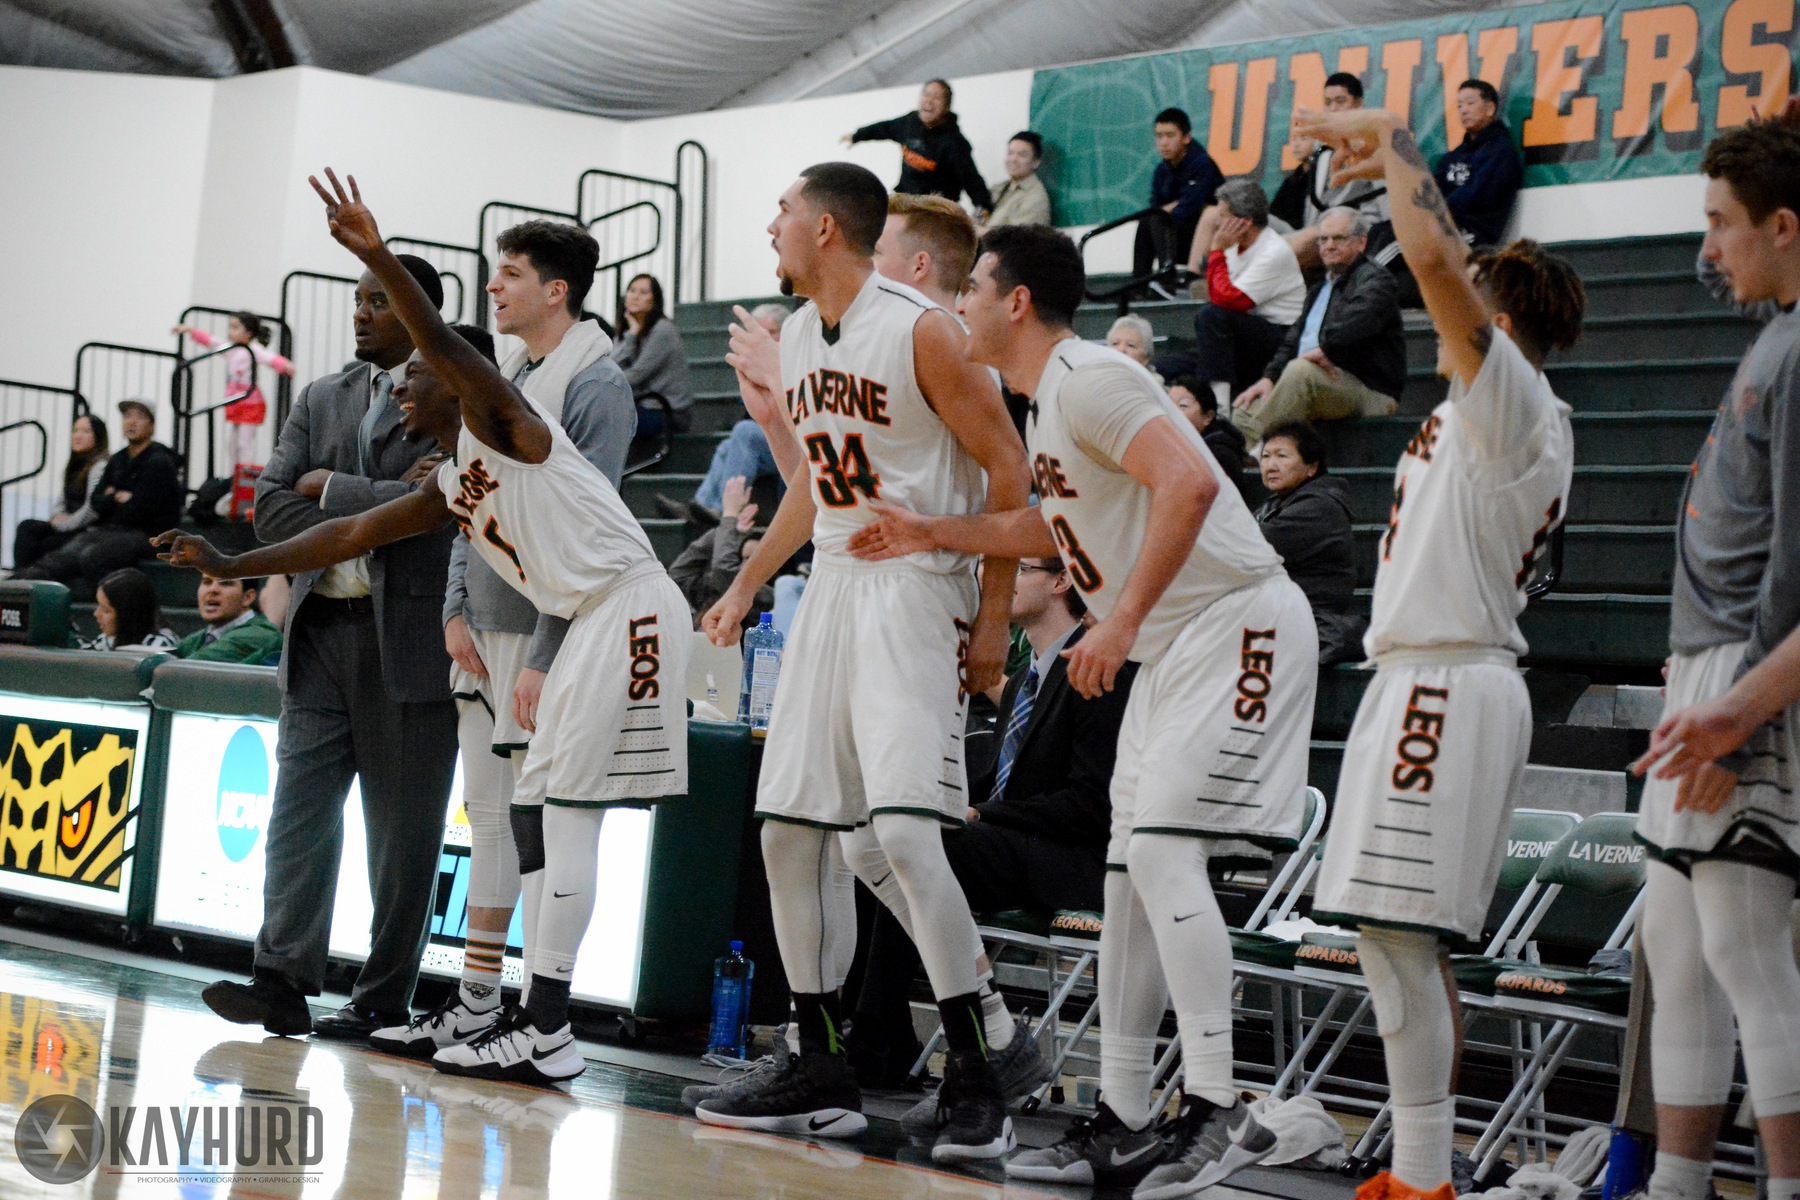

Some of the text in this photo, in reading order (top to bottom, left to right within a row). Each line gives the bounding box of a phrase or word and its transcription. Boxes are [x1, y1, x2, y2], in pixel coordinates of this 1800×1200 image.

[808, 368, 891, 427] VERNE
[804, 432, 882, 508] 34
[628, 613, 661, 701] LEOS
[1233, 627, 1276, 723] LEOS
[1391, 683, 1449, 794] LEOS
[1568, 840, 1646, 864] LA VERNE
[1051, 915, 1104, 932] LEOPARD
[1295, 945, 1358, 966] LEOPARDS
